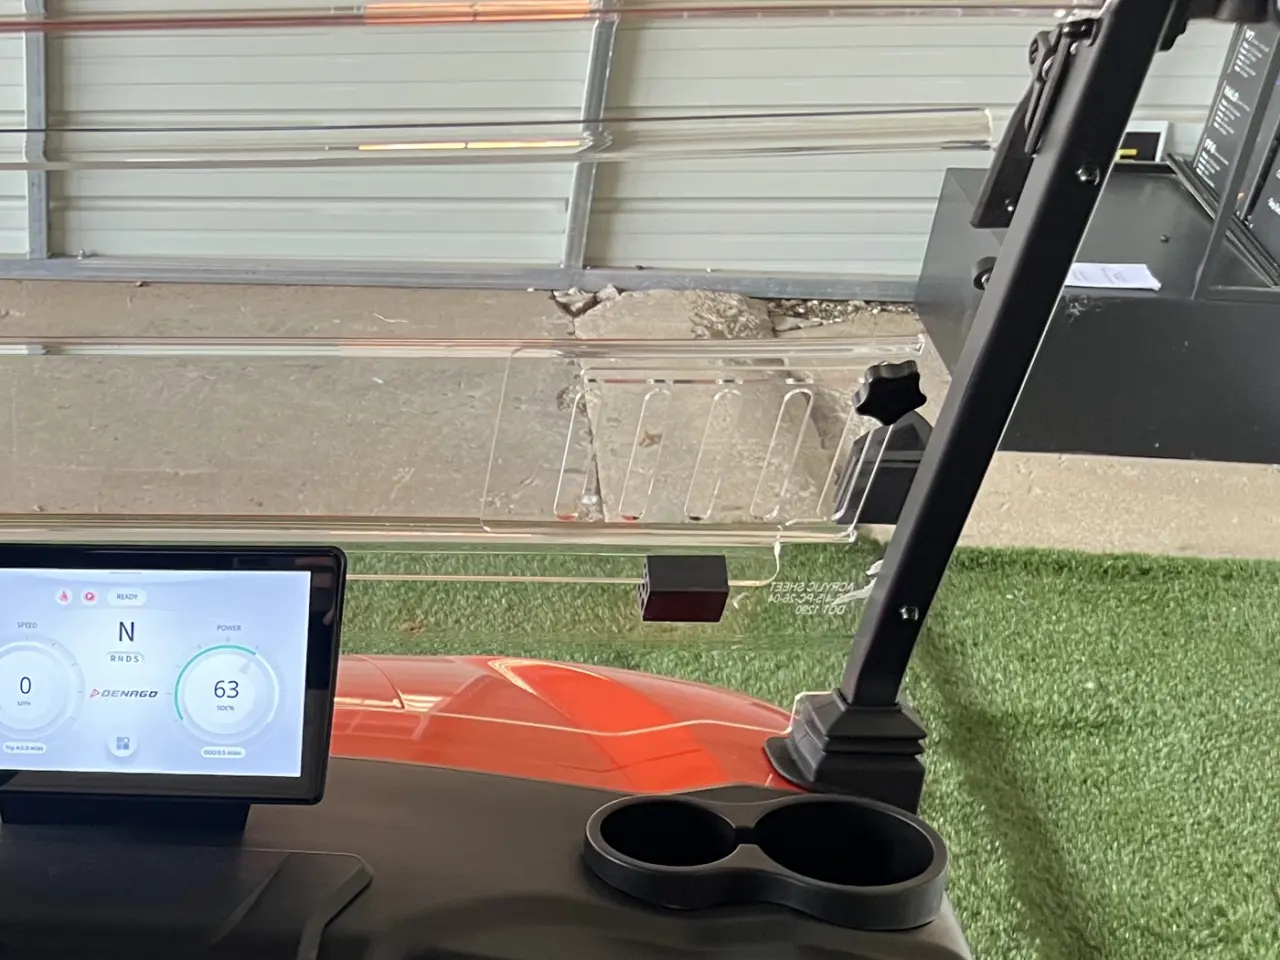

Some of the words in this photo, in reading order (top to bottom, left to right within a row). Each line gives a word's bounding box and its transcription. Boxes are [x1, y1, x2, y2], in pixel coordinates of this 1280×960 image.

[17, 621, 38, 629] SPEED
[118, 621, 135, 642] N
[216, 624, 242, 632] POWER
[20, 676, 32, 695] 0
[214, 680, 240, 699] 63
[100, 689, 159, 698] DENAGO
